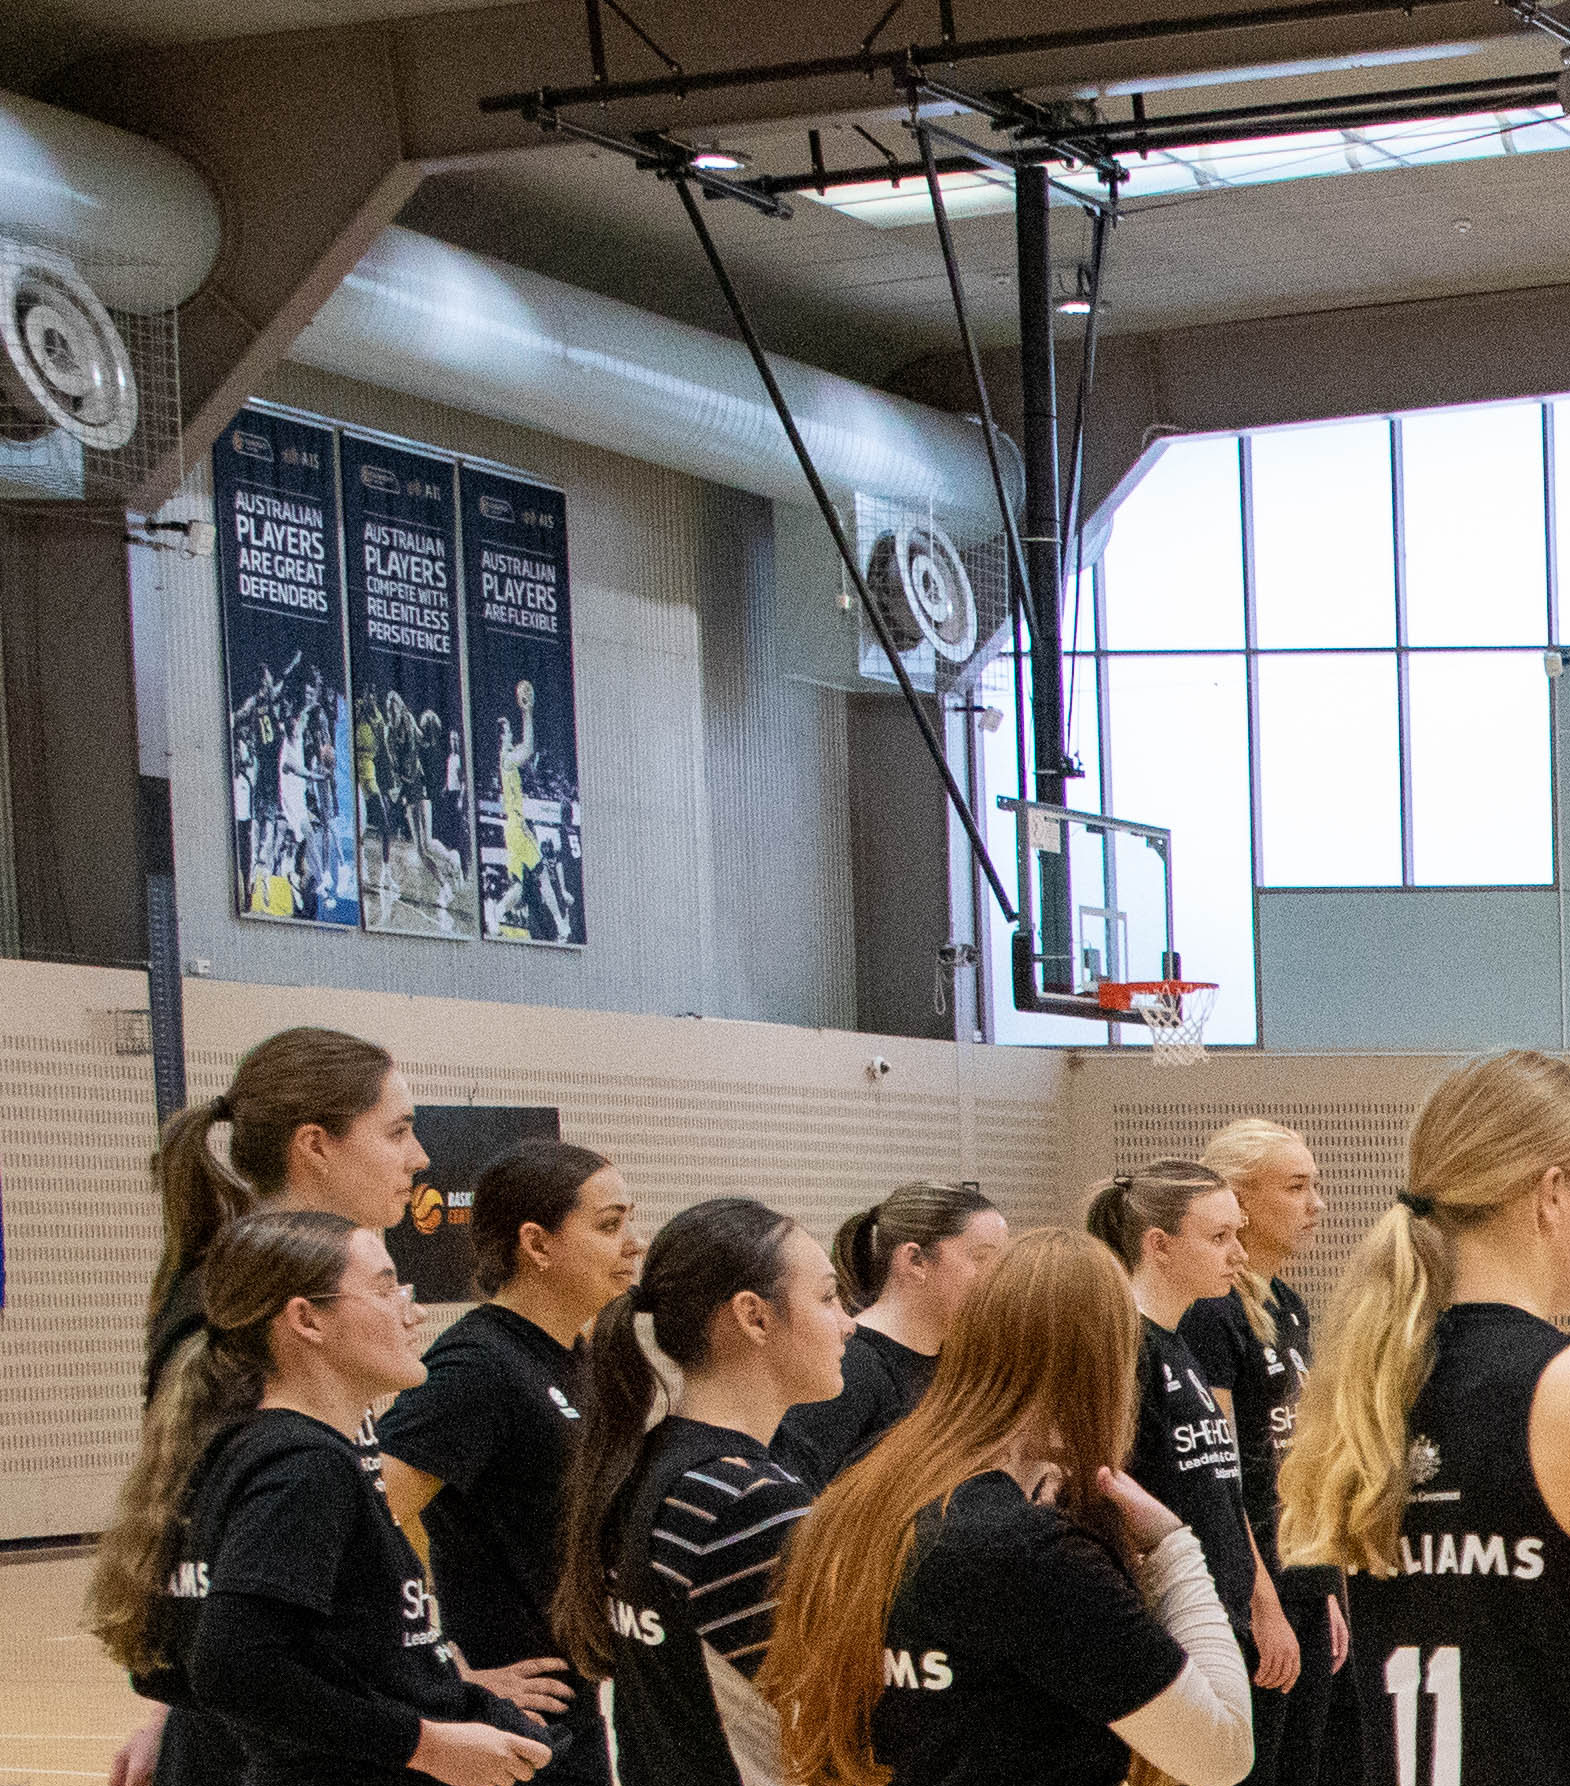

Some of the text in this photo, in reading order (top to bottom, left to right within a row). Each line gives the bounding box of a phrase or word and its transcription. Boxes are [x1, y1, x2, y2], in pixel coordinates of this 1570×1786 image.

[235, 490, 323, 529] AUSTRALIAN
[236, 513, 325, 560] PLAYERS
[364, 522, 445, 557] AUSTRALIAN
[239, 548, 325, 586] ARE GREAT
[364, 545, 447, 588] PLAYERS
[481, 551, 557, 583] AUSTRALIAN
[239, 574, 328, 612] DEFENDERS
[366, 575, 449, 609] COMPETE WITH
[482, 571, 558, 613] PLAYERS
[367, 597, 449, 630] RELENTLESS
[485, 603, 557, 633] ARE FLEXIBLE
[368, 620, 450, 653] PERSISTENCE
